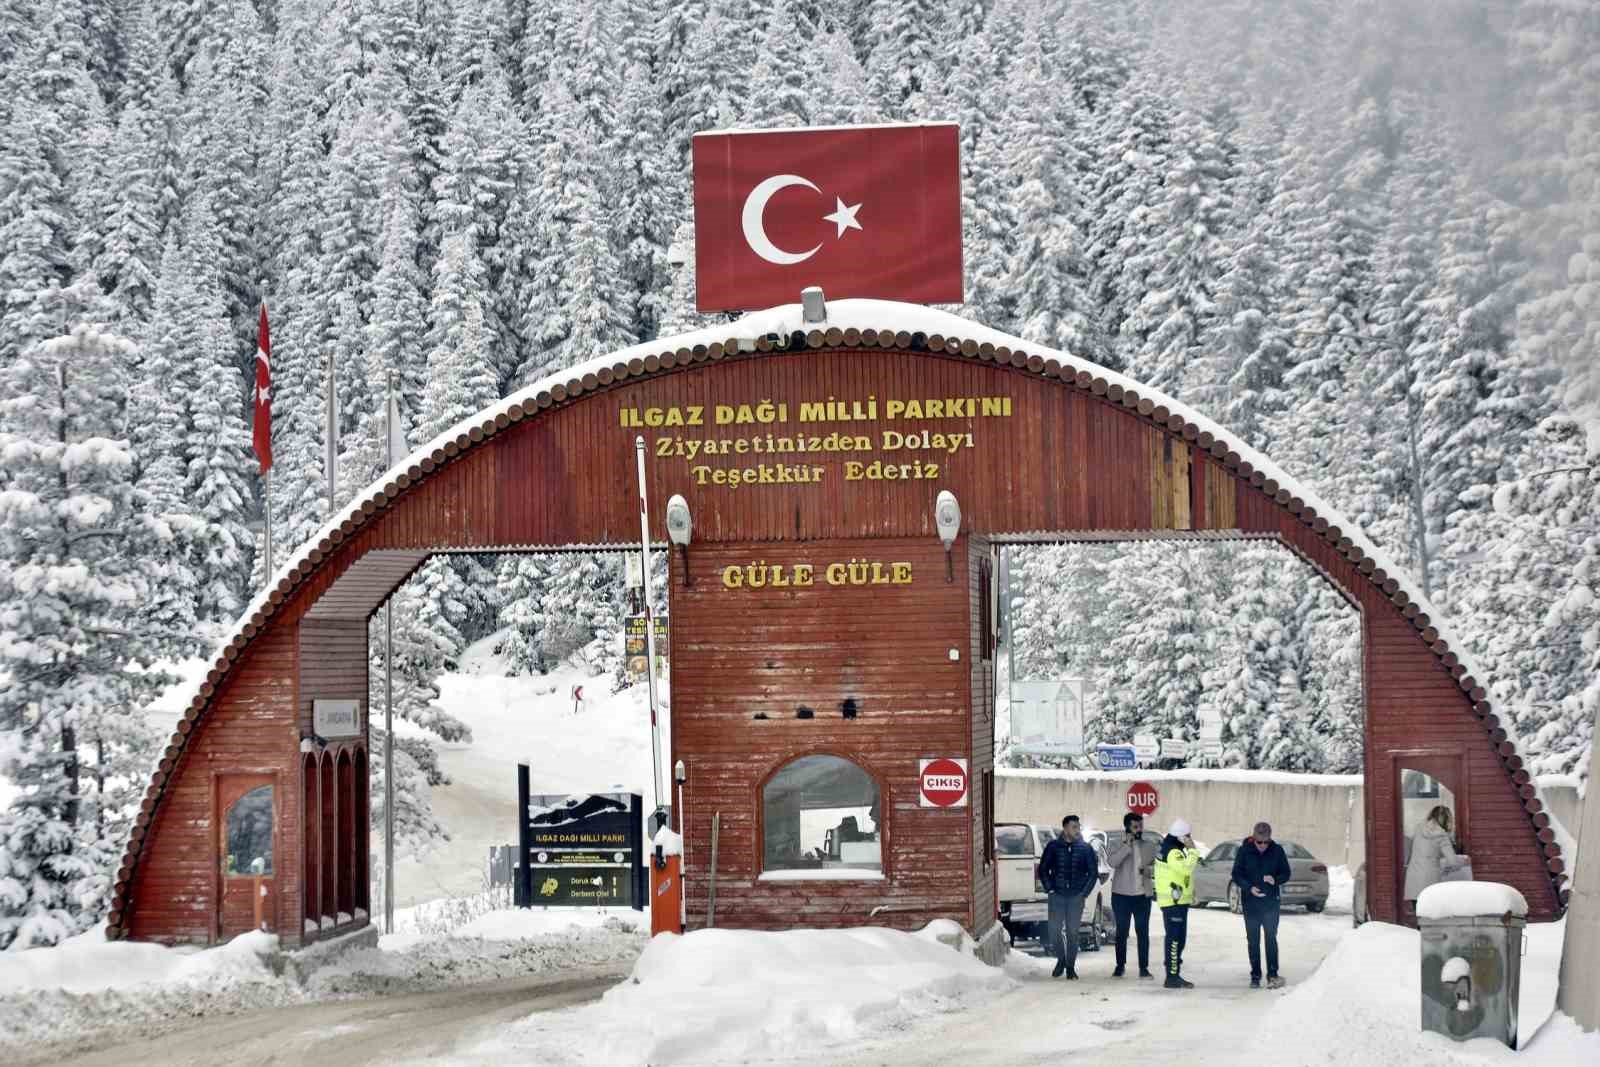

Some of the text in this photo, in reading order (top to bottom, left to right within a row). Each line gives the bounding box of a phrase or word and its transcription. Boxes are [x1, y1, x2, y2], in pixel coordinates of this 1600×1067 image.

[619, 395, 1012, 428] ILGAZ DAĞI MİLLİ PARKI'NI
[656, 430, 975, 460] Ziyaretinizden Dolayı
[691, 460, 940, 489] Teşekkür Ederiz
[722, 558, 914, 587] GÜLE GÜLE
[927, 777, 960, 789] ÇIKIŞ
[1128, 793, 1157, 807] DUR
